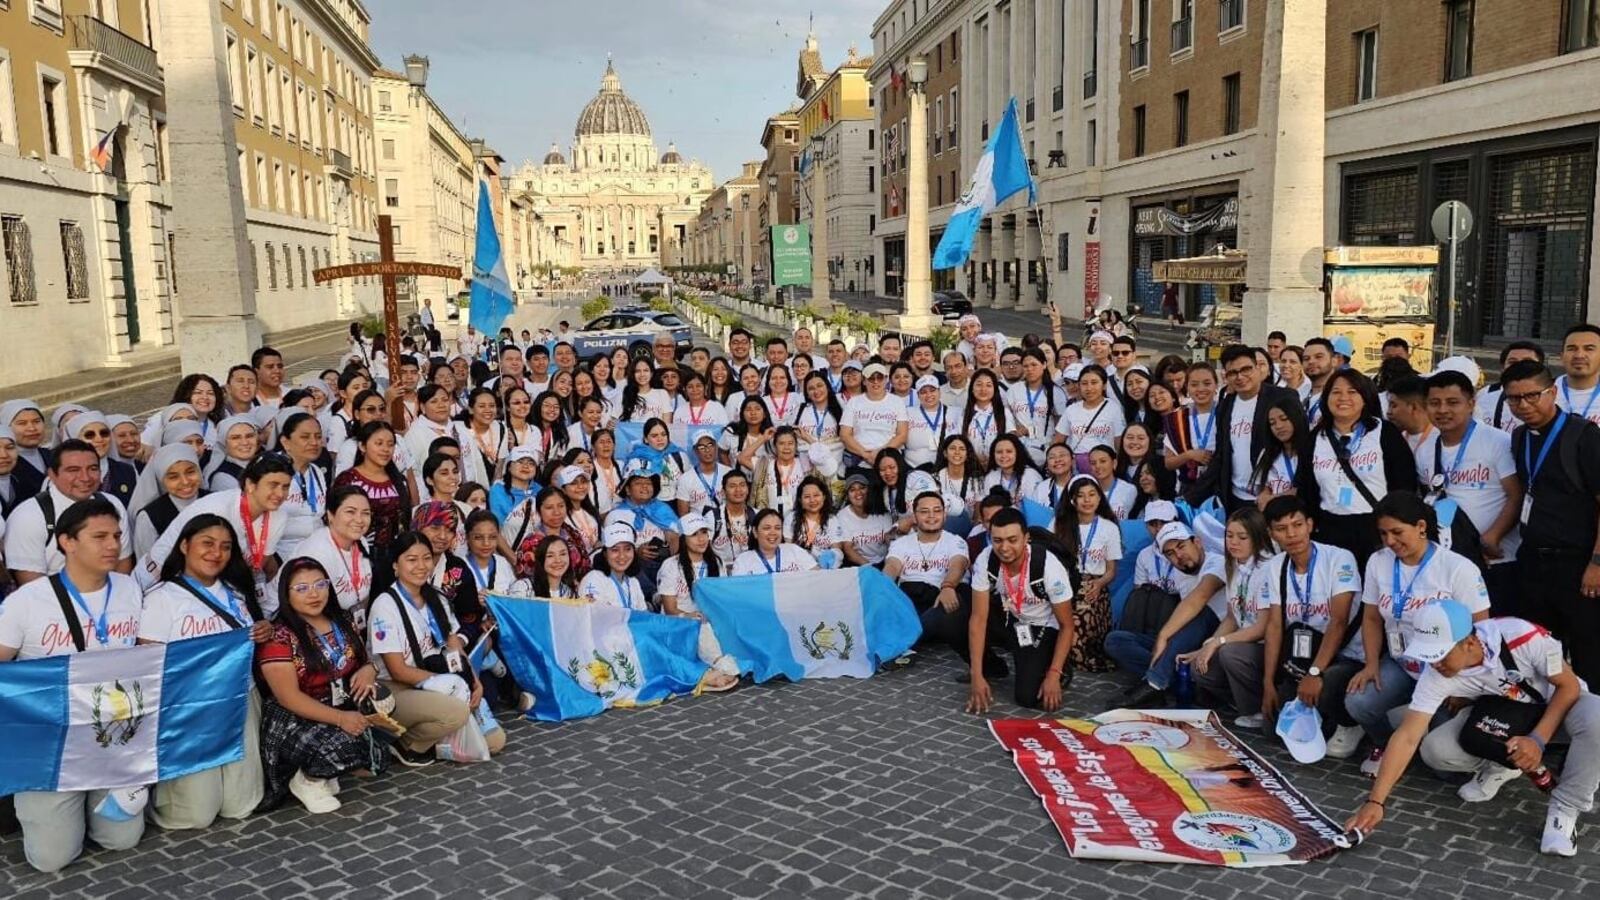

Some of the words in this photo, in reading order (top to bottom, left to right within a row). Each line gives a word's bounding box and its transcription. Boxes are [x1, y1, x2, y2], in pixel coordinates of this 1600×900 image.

[318, 269, 343, 280] APRI
[350, 266, 365, 275] LA
[371, 264, 405, 275] PORTA
[408, 264, 417, 274] A
[419, 265, 458, 278] CRISTO
[386, 287, 395, 312] TUO
[388, 322, 400, 382] SALVATO
